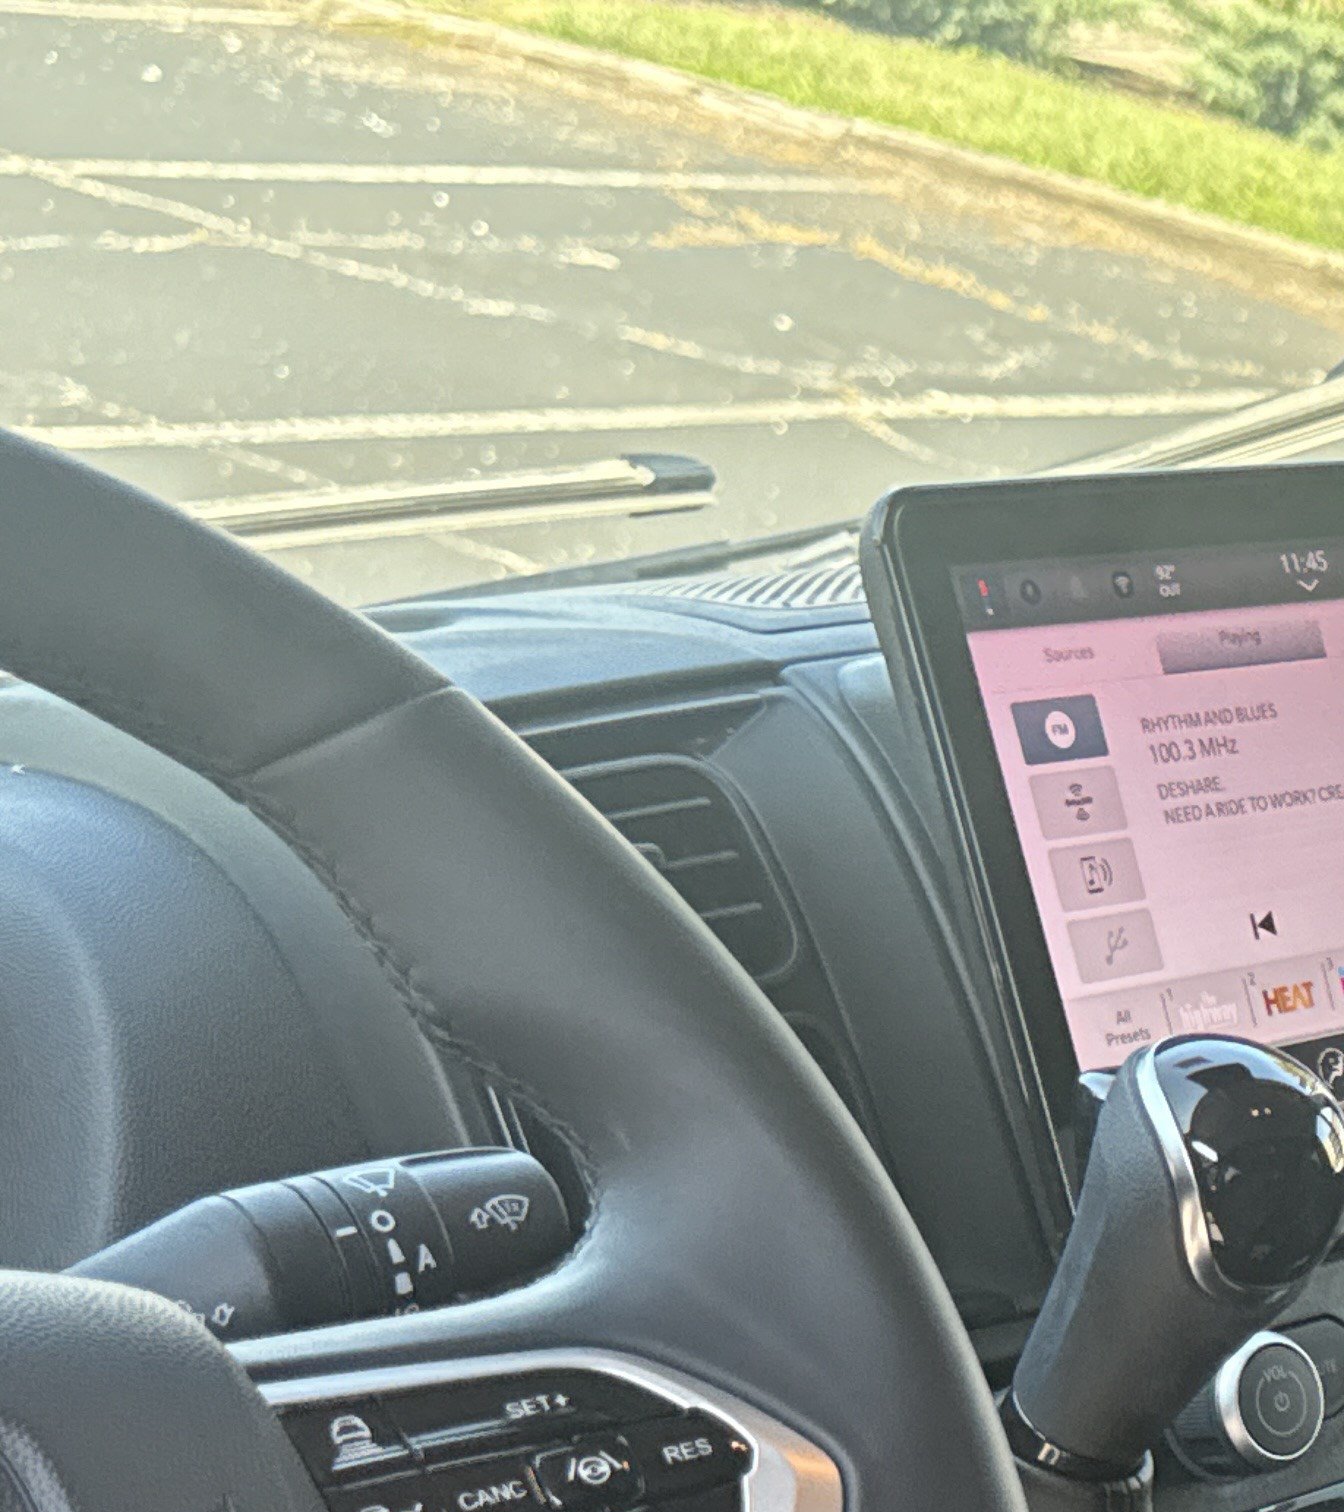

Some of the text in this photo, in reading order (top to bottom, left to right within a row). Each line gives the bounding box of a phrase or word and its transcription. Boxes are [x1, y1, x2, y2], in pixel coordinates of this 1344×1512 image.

[1279, 549, 1328, 575] 11:45
[1218, 628, 1263, 647] Playing
[1043, 646, 1095, 664] Sources
[1051, 723, 1069, 737] FM
[1139, 702, 1278, 734] RHYTHM AND BLUES
[1149, 735, 1240, 765] 100.3 MHz
[1163, 804, 1203, 824] NEED
[1205, 802, 1216, 818] A
[1215, 797, 1248, 817] RIDE
[1248, 795, 1269, 813] TO
[1262, 980, 1316, 1016] HEAT
[1116, 1009, 1131, 1025] All
[1105, 1028, 1150, 1046] Presets
[416, 1242, 438, 1274] A
[1262, 1364, 1289, 1383] VOL
[662, 1437, 713, 1465] RES
[457, 1480, 529, 1512] CANC
